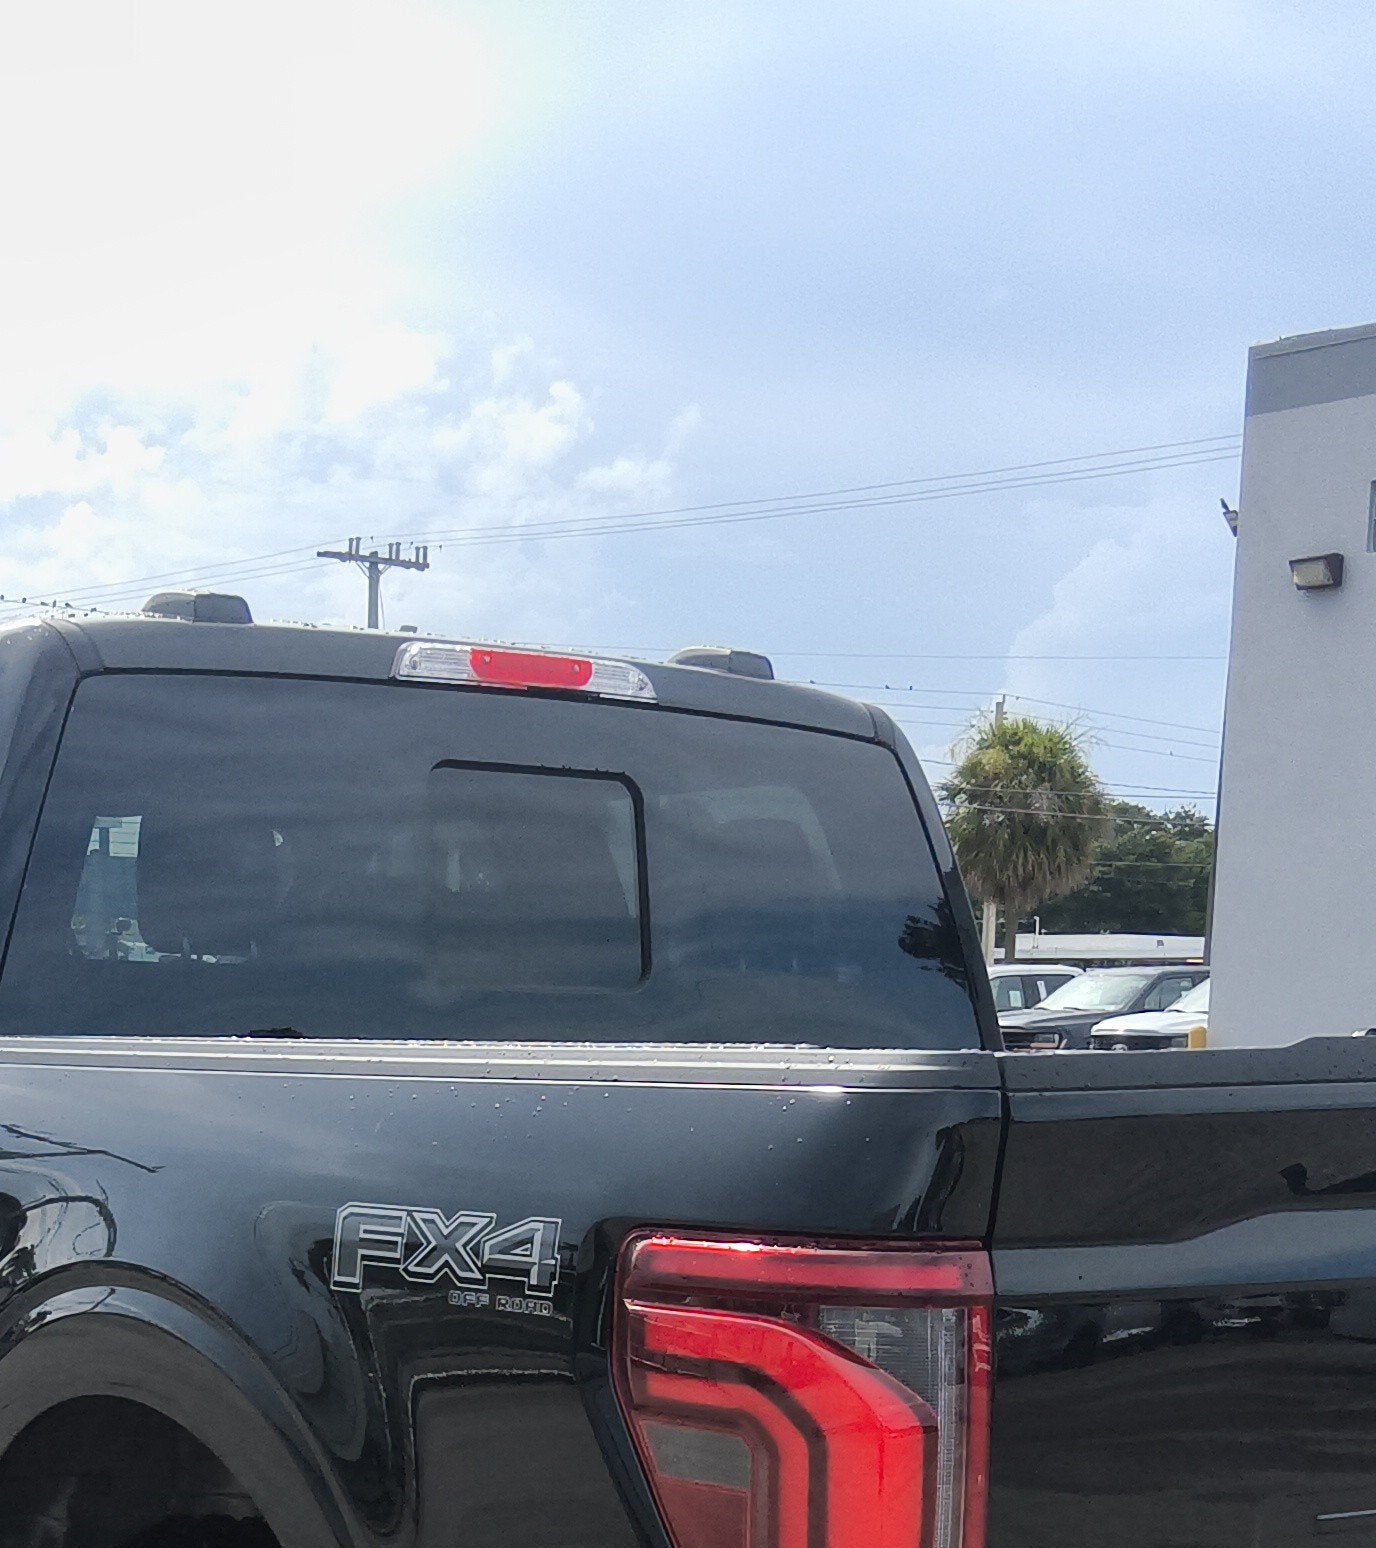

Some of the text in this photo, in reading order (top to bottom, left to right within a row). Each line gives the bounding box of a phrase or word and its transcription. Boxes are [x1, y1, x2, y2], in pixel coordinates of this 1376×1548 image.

[330, 1201, 562, 1297] FX4
[447, 1290, 554, 1317] OFF ROAD
